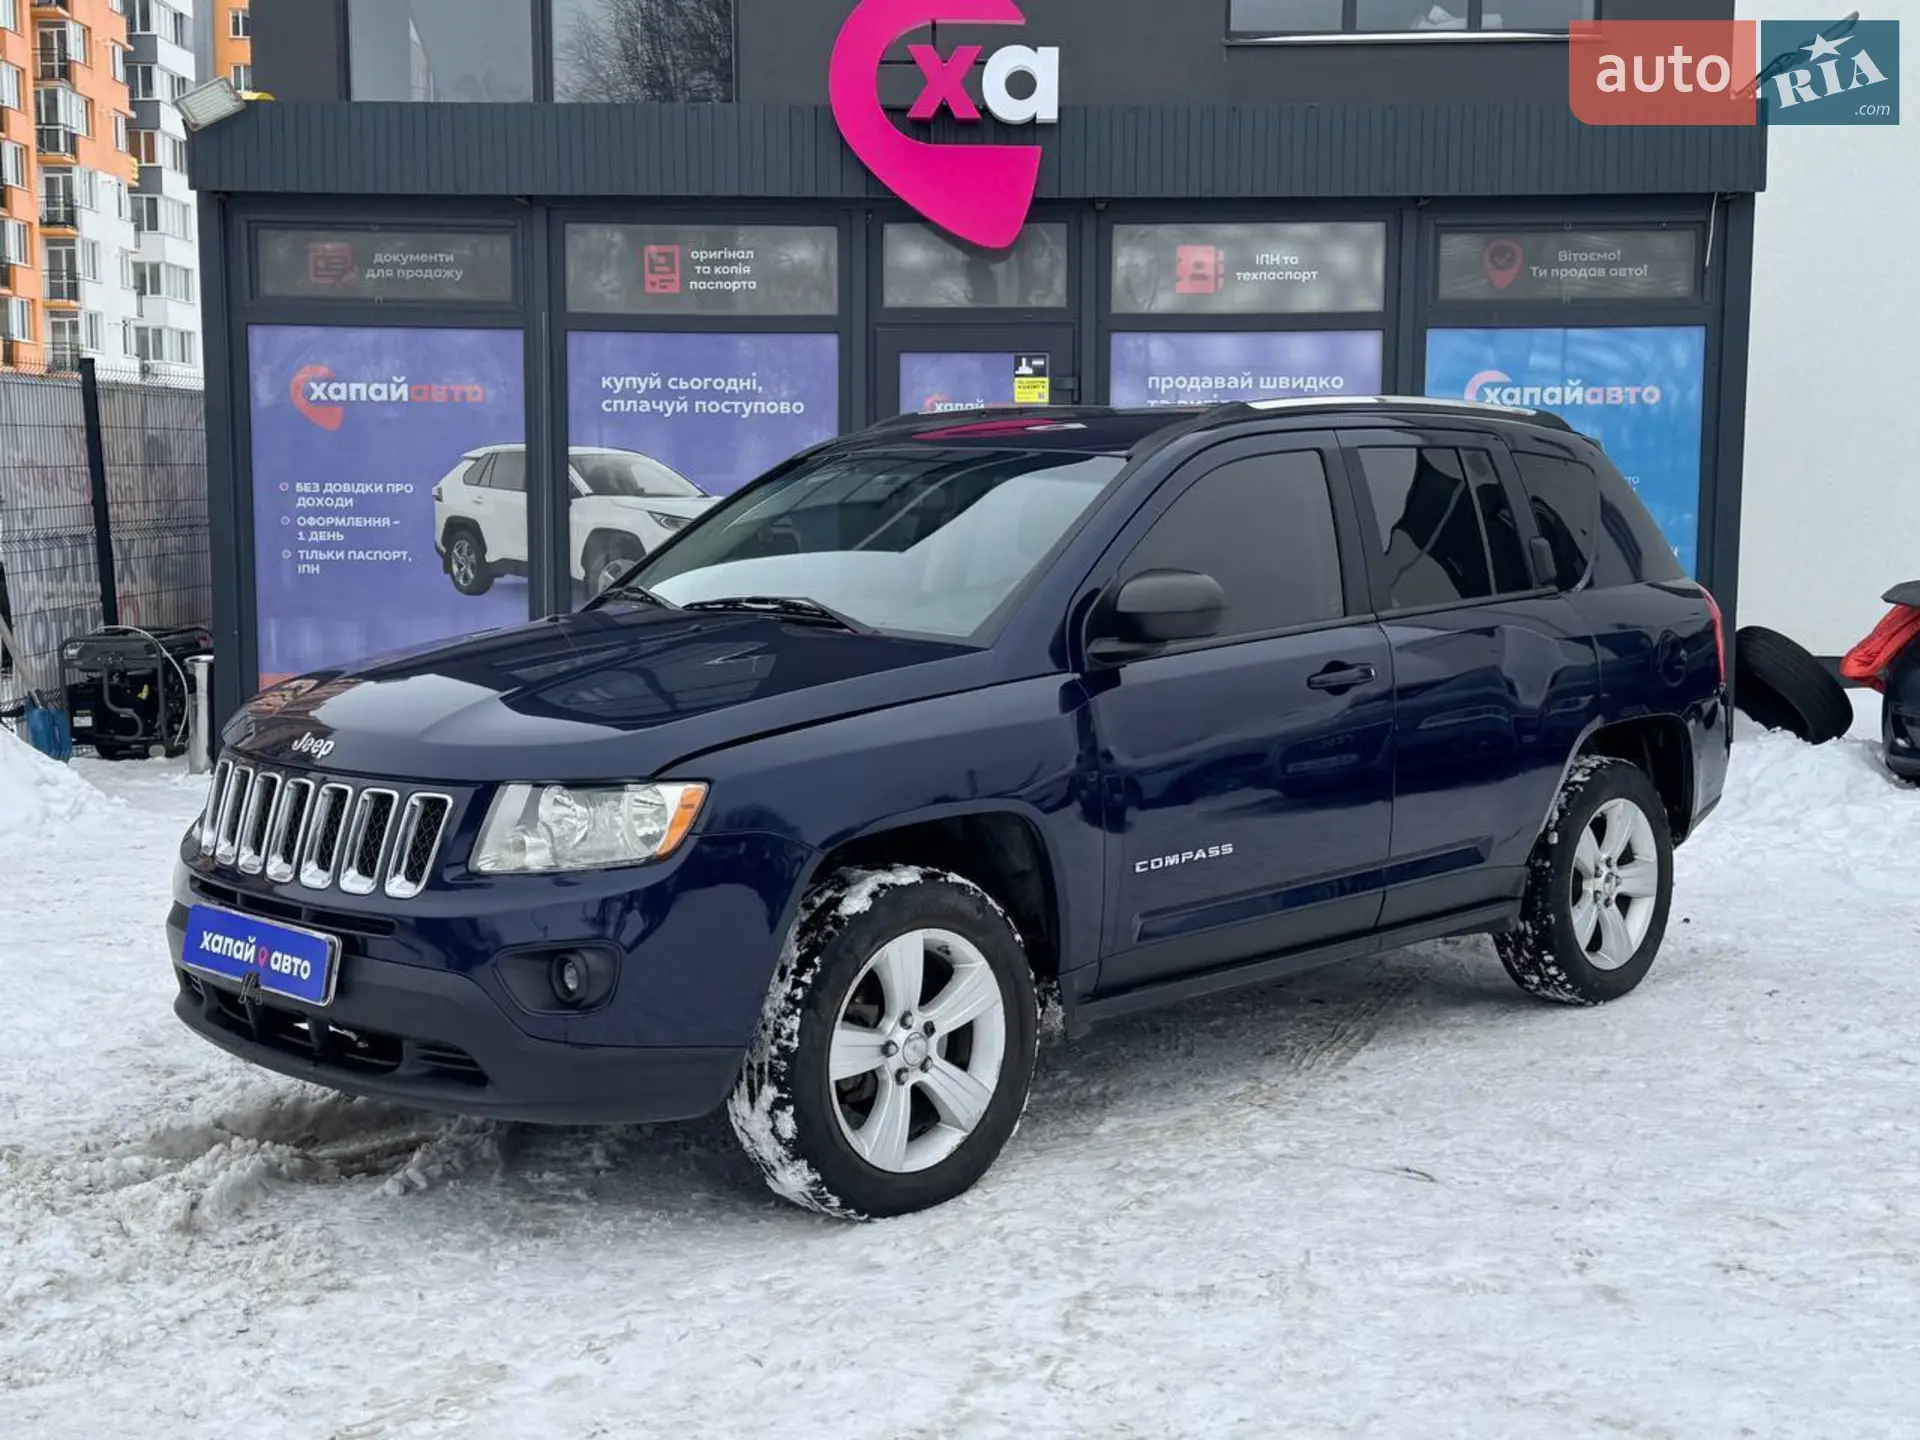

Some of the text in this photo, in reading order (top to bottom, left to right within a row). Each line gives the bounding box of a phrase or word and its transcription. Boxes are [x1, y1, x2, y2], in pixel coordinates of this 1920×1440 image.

[373, 253, 454, 265] документи
[690, 247, 754, 260] оригінал
[1558, 250, 1621, 262] Вітаємо!
[695, 262, 751, 275] та копія
[1530, 264, 1649, 280] Ти продав авто!
[365, 269, 463, 281] для продажу
[1236, 270, 1318, 282] техпаспорт
[689, 279, 757, 292] паспорта
[601, 372, 763, 393] купуй сьогодні,
[1148, 372, 1344, 394] продавай швидко
[601, 397, 805, 418] сплачуй поступово
[296, 482, 414, 494] БЕЗ ДОВІДКИ ПРО
[296, 497, 354, 508] ДОХОДИ
[296, 516, 390, 527] ОФОРМЛЕННЯ
[297, 531, 344, 542] 1 ДЕНЬ
[298, 550, 345, 561] ТІЛЬКИ
[298, 564, 320, 574] ІПН
[292, 731, 336, 759] Jeep
[1135, 843, 1234, 873] COMPASS
[200, 930, 311, 980] хапай авто
